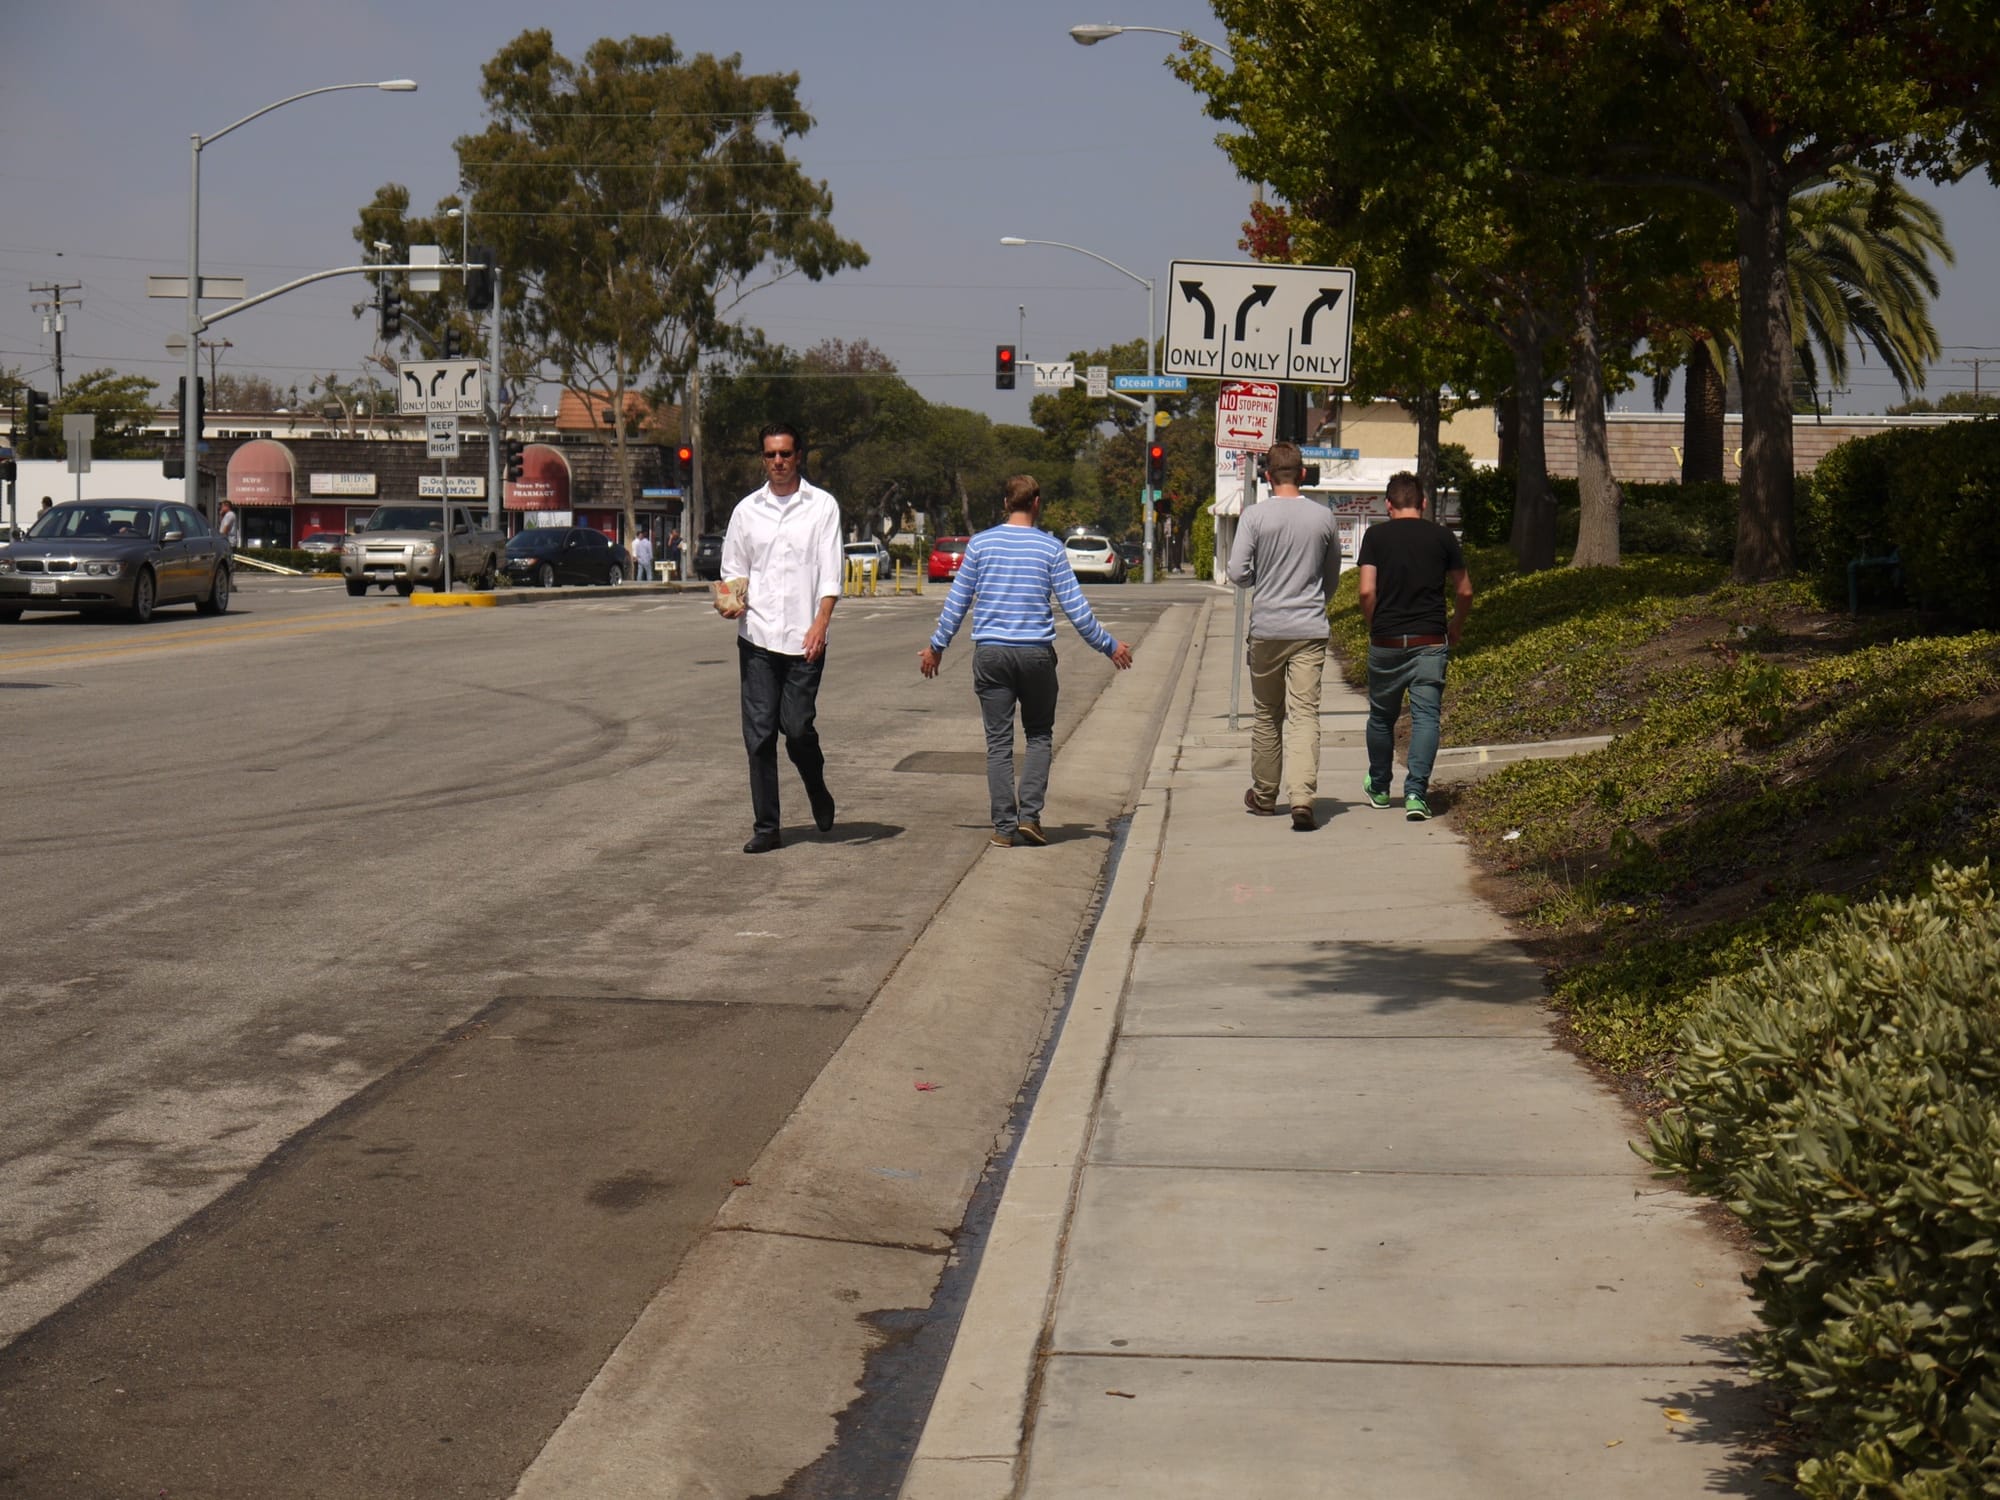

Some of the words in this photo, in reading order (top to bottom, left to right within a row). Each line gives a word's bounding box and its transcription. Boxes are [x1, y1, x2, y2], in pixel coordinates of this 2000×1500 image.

[1171, 348, 1219, 367] ONLY
[1231, 351, 1280, 371] ONLY
[1293, 355, 1342, 374] ONLY
[1119, 377, 1153, 388] Ocean
[1158, 377, 1182, 388] Park
[402, 401, 425, 411] ONLY
[430, 401, 453, 410] ONLY
[458, 399, 481, 409] ONLY
[1221, 394, 1236, 410] NO
[1238, 399, 1273, 413] STOPPING
[430, 420, 454, 430] KEEP
[1225, 414, 1244, 426] ANY
[1247, 415, 1268, 428] TIME
[430, 443, 456, 453] RIGHT
[457, 478, 477, 486] Park
